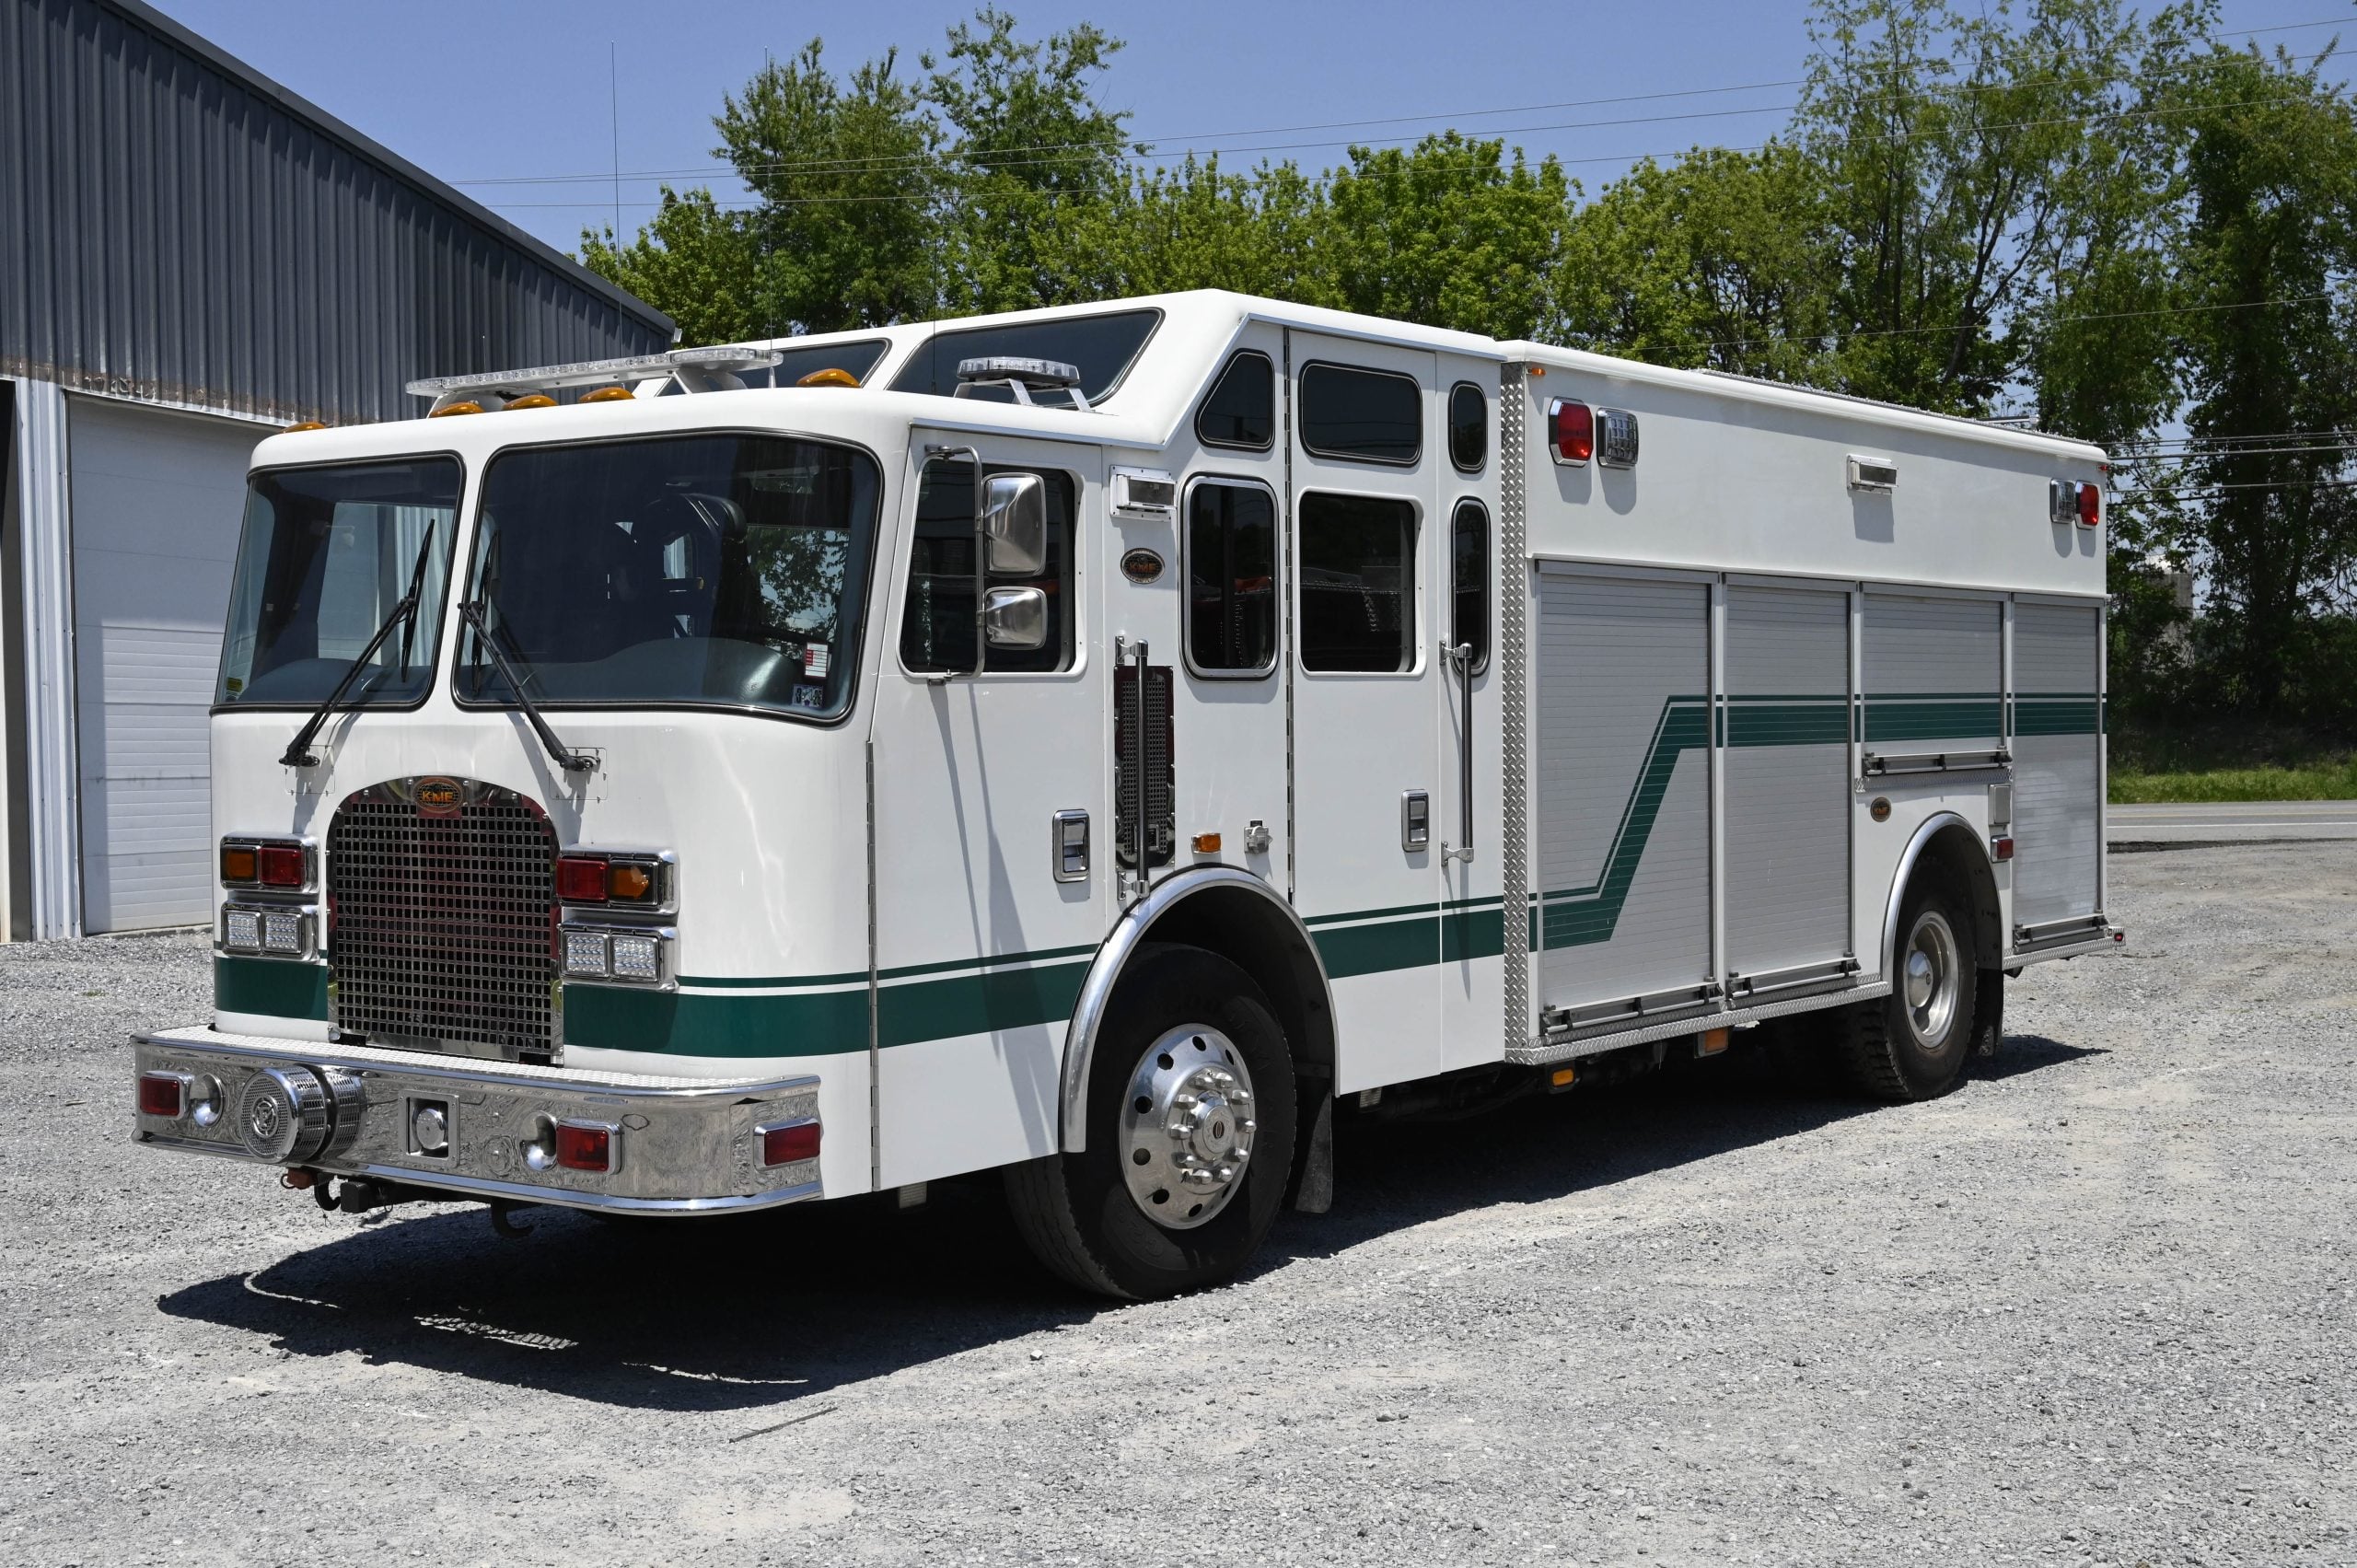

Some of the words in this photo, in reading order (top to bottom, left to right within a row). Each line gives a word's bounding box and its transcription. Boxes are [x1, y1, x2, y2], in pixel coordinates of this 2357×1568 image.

[1129, 562, 1157, 572] KME
[795, 687, 802, 703] 3
[422, 791, 454, 802] KME
